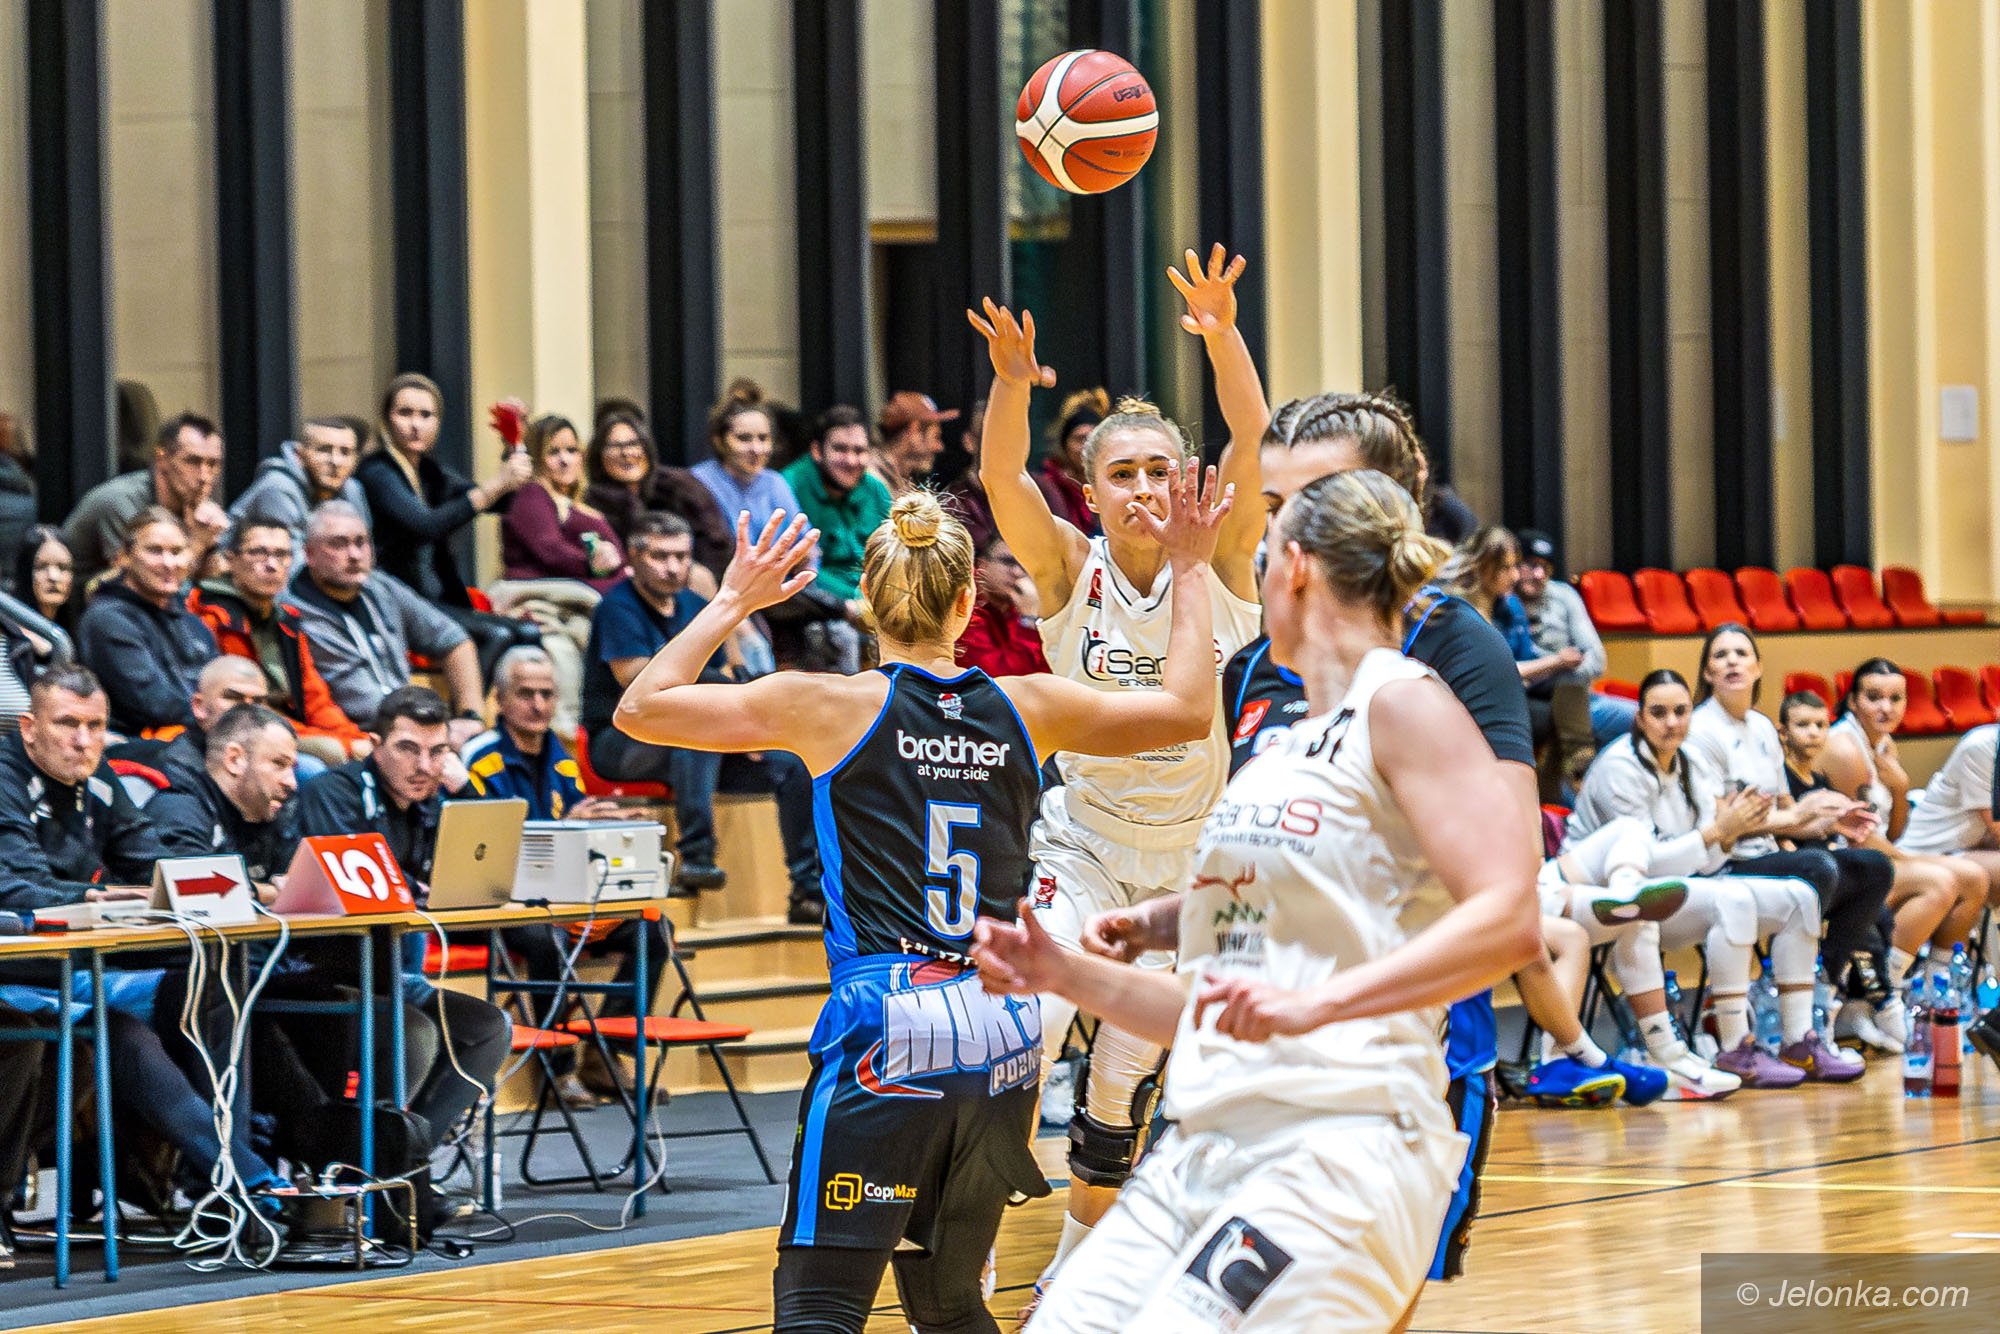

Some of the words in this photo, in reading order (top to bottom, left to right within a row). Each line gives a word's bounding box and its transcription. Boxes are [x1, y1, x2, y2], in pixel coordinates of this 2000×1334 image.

[896, 729, 1011, 767] brother
[917, 764, 932, 777] at
[932, 766, 962, 781] your
[962, 766, 990, 781] side
[320, 848, 390, 902] 5
[924, 800, 982, 941] 5
